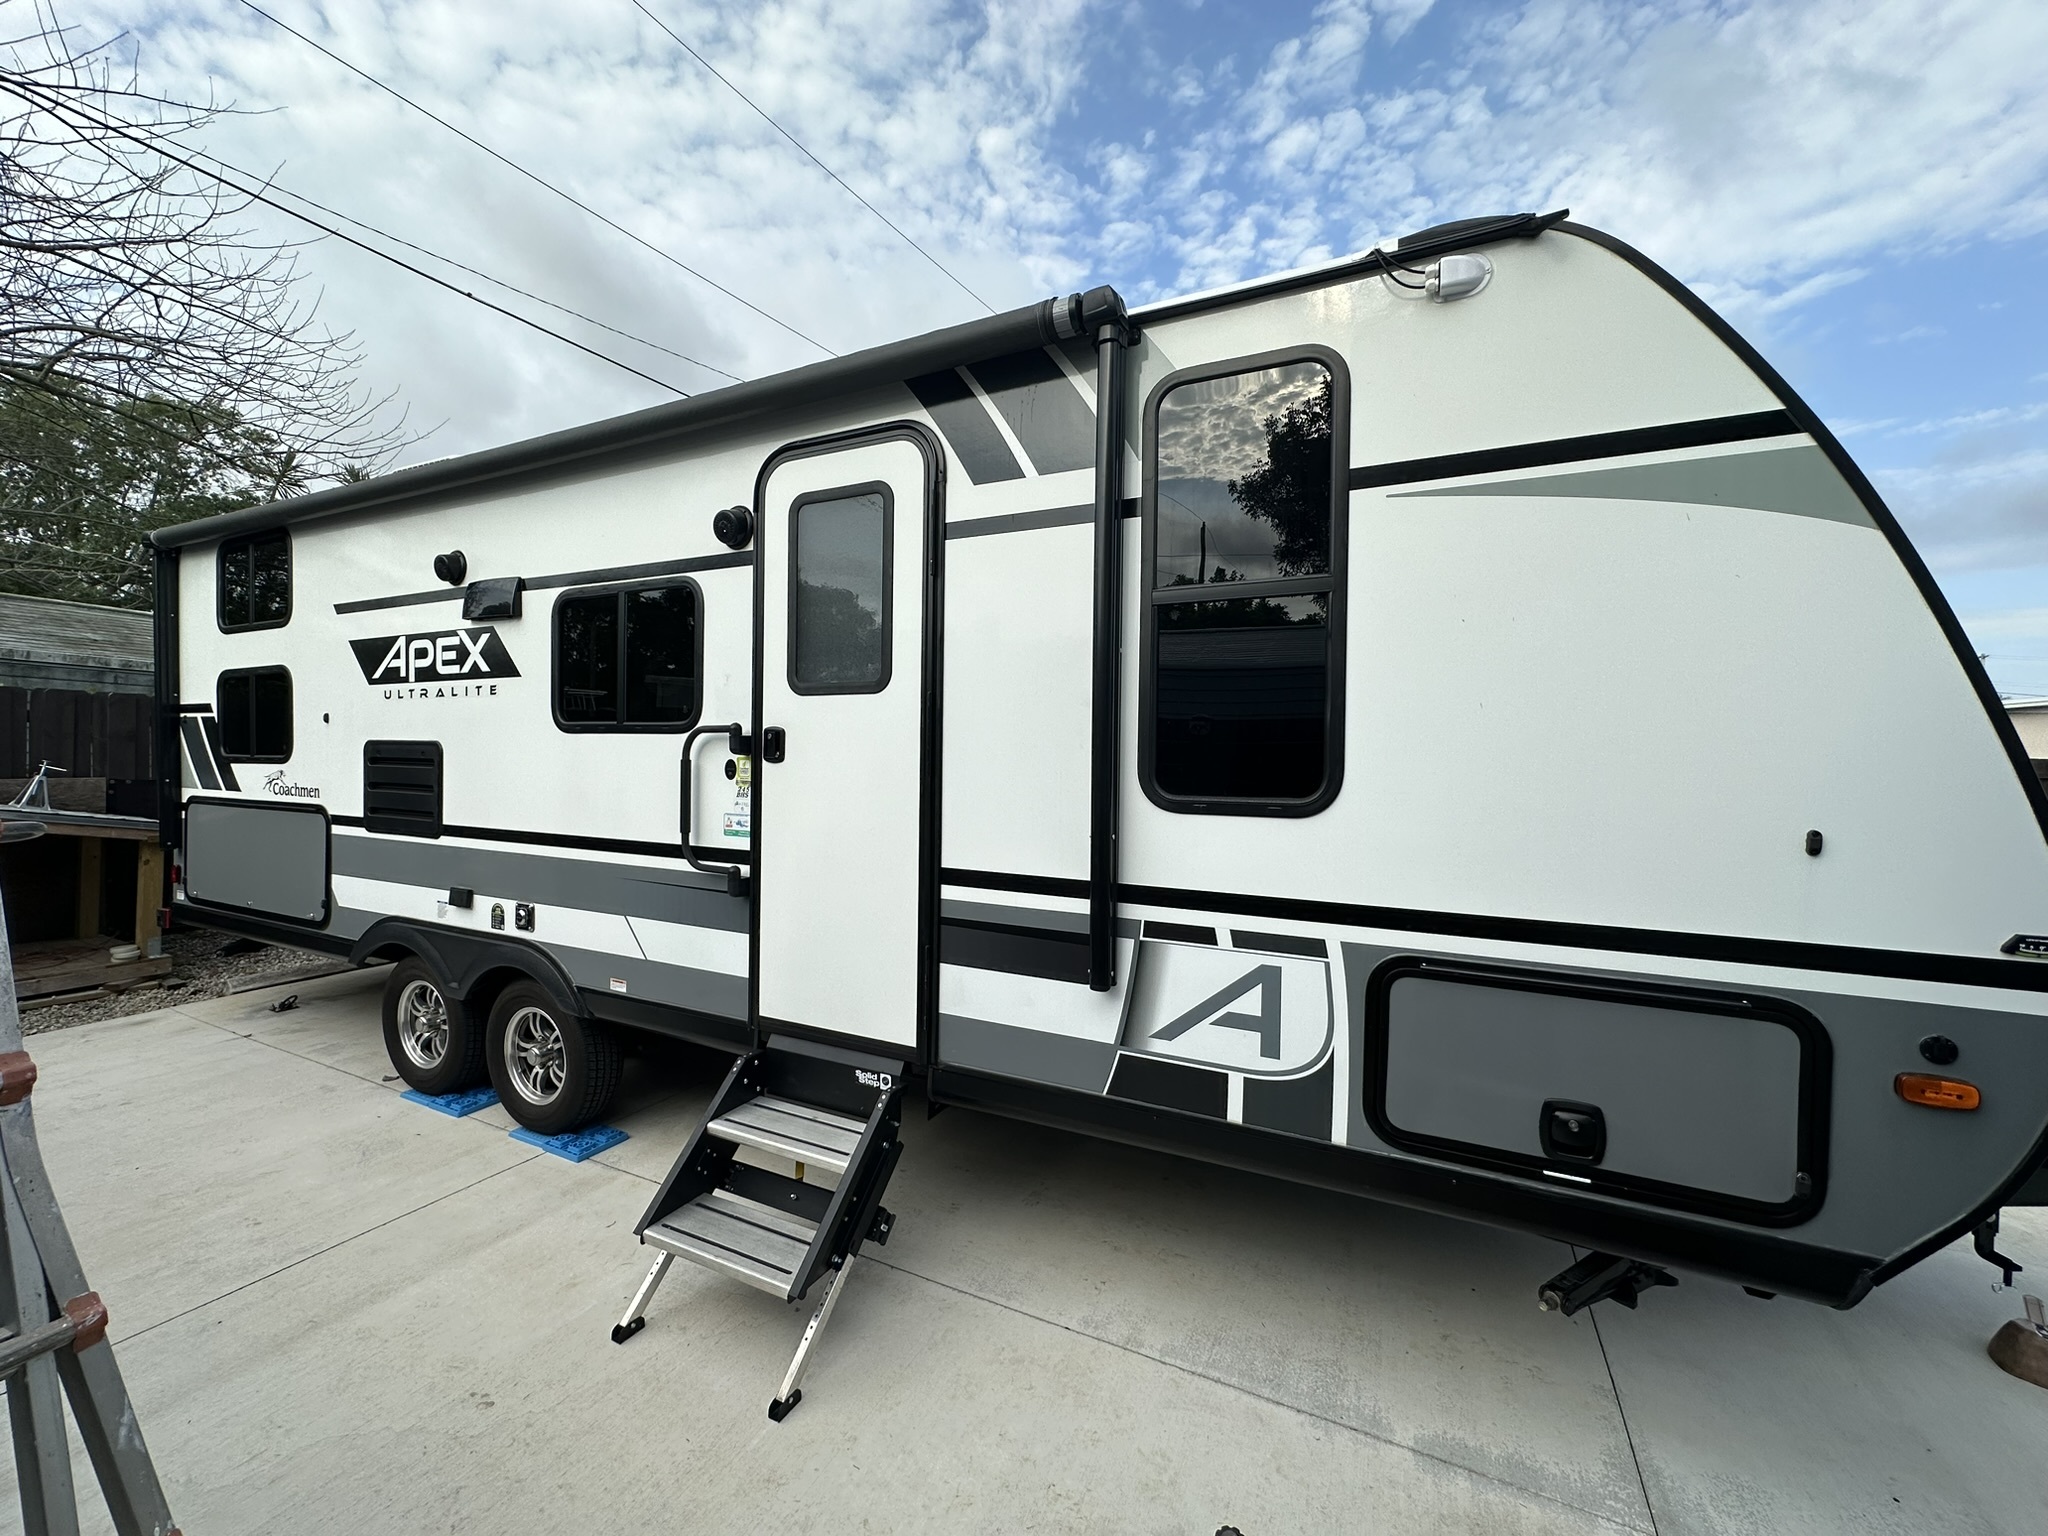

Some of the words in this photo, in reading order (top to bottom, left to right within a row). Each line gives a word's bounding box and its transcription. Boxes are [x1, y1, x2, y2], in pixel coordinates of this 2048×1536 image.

[371, 630, 491, 682] APEX
[384, 685, 497, 699] ULTRALITE
[272, 782, 320, 798] Coachmen
[1148, 963, 1282, 1060] A
[855, 1069, 878, 1080] Solid
[859, 1077, 880, 1087] Step
